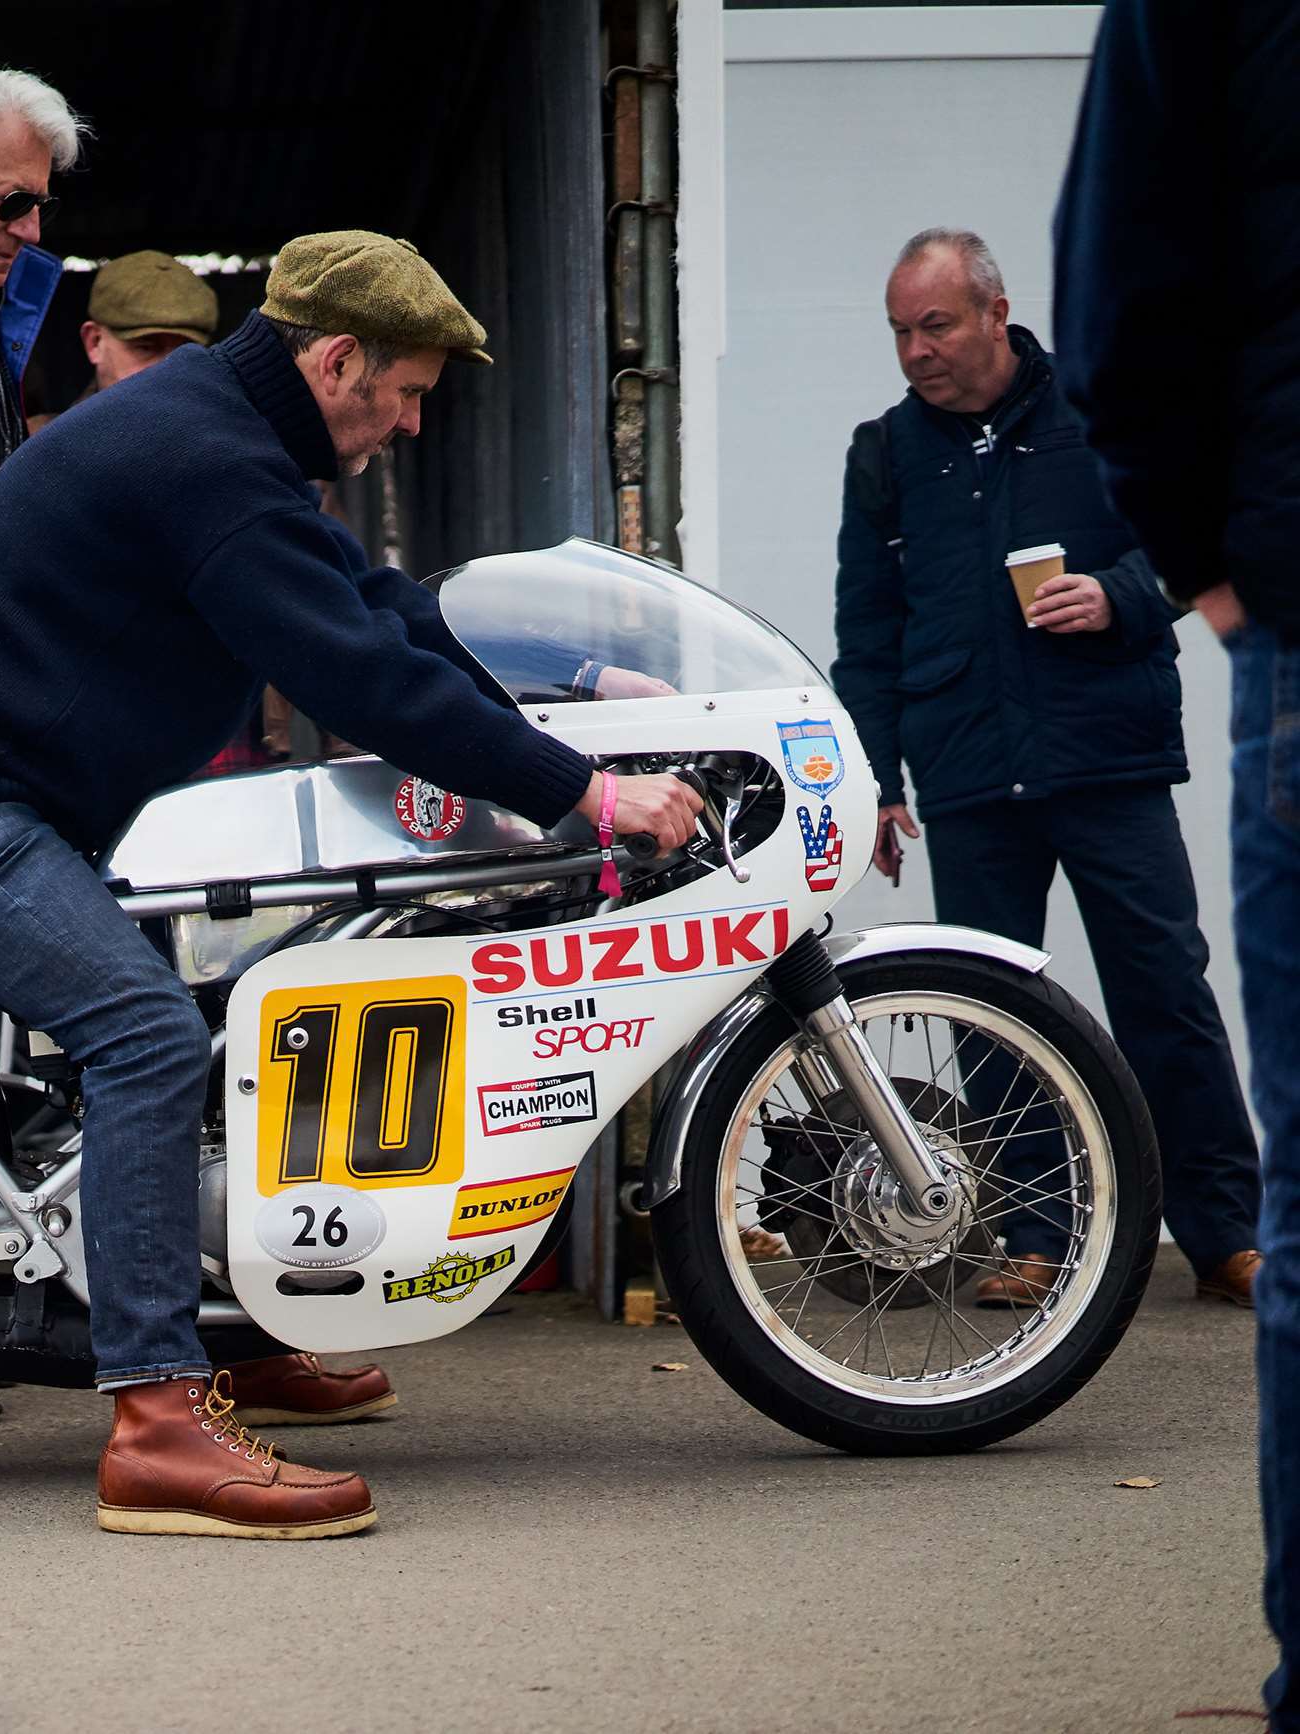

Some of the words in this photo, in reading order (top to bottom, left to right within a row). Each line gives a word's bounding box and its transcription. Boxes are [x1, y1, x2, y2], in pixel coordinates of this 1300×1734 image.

[471, 907, 789, 995] SUZUKI
[497, 997, 597, 1028] Shell
[532, 1016, 656, 1059] SPORT
[270, 997, 455, 1184] 10
[511, 1080, 544, 1091] EQUIPPED
[544, 1078, 562, 1087] WITH
[487, 1088, 589, 1119] CHAMPION
[519, 1120, 542, 1130] SPARK
[542, 1117, 563, 1126] PLUGS
[458, 1186, 565, 1220] DUNLOP
[291, 1204, 349, 1248] 26
[323, 1245, 372, 1268] MASTERCARD
[387, 1249, 513, 1301] RENOLD
